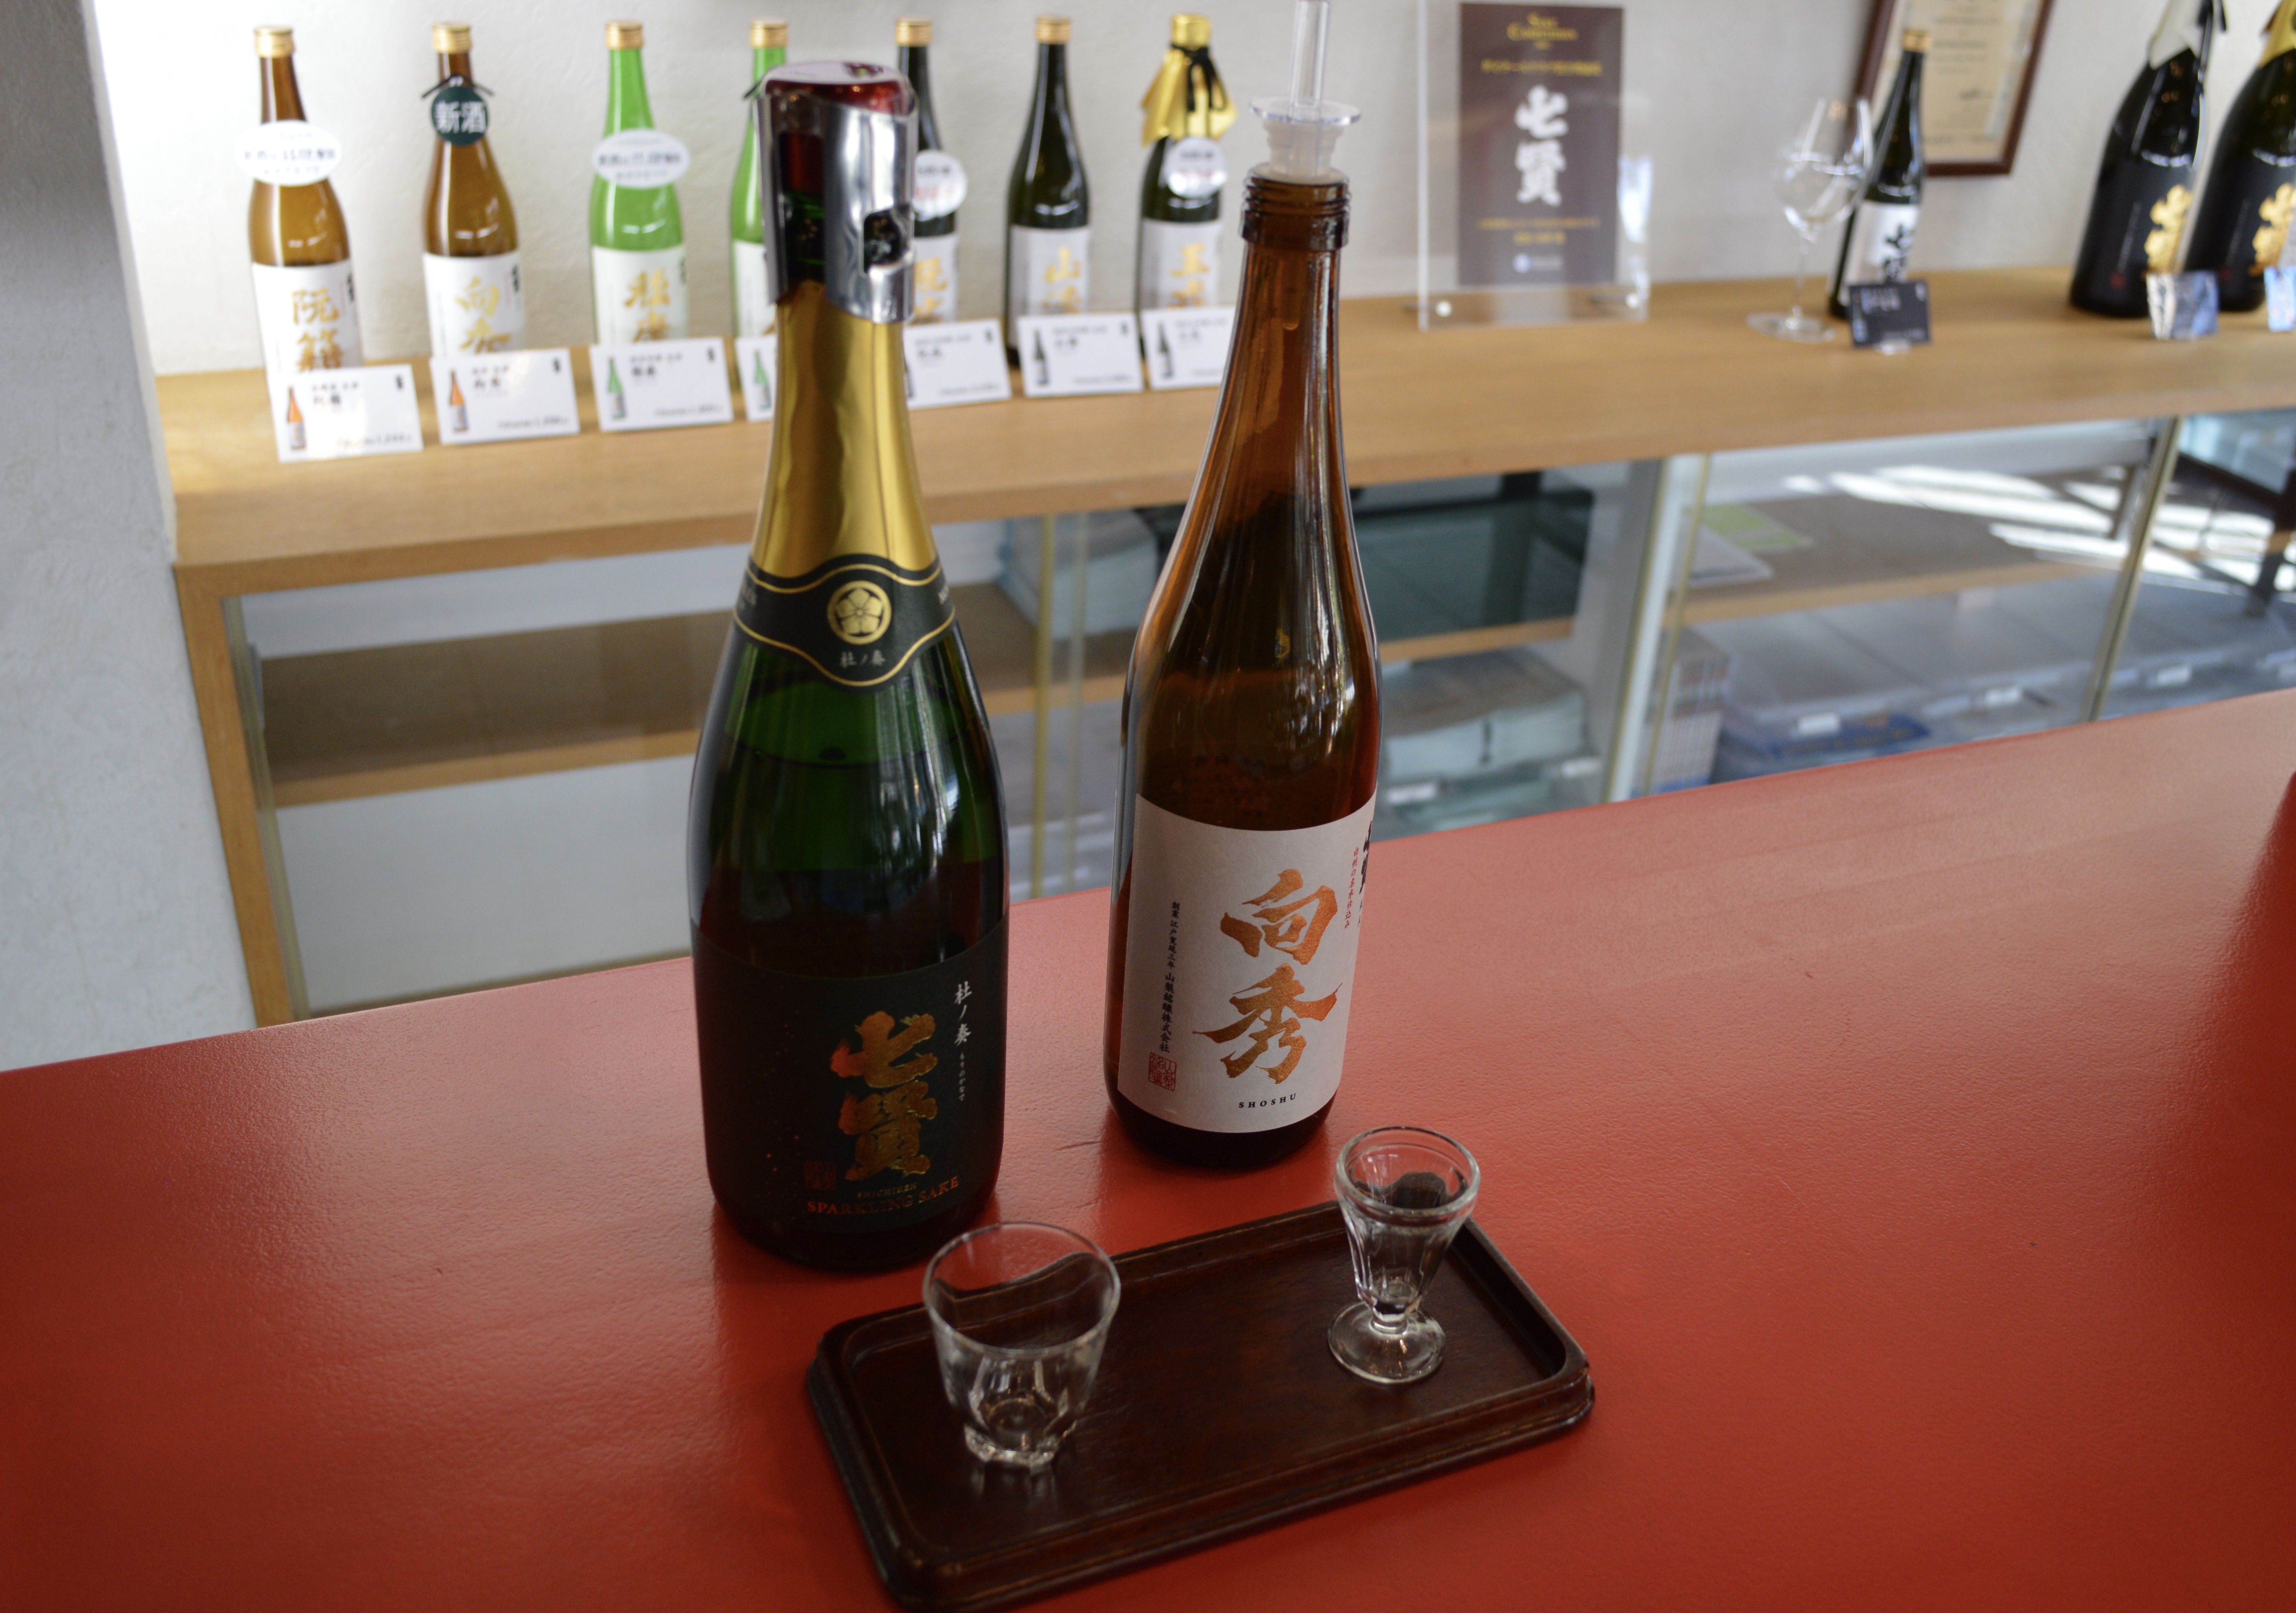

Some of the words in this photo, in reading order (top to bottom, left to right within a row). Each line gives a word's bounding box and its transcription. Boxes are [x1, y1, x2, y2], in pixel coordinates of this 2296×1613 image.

[436, 100, 486, 134] 新酒
[1192, 869, 1343, 1085] 向秀
[954, 981, 972, 1047] 杜ノ奏
[830, 1011, 938, 1181] 七賢
[1239, 1093, 1296, 1109] SHOSHU
[807, 1195, 913, 1215] SPARKLING
[919, 1176, 958, 1203] SAKE
